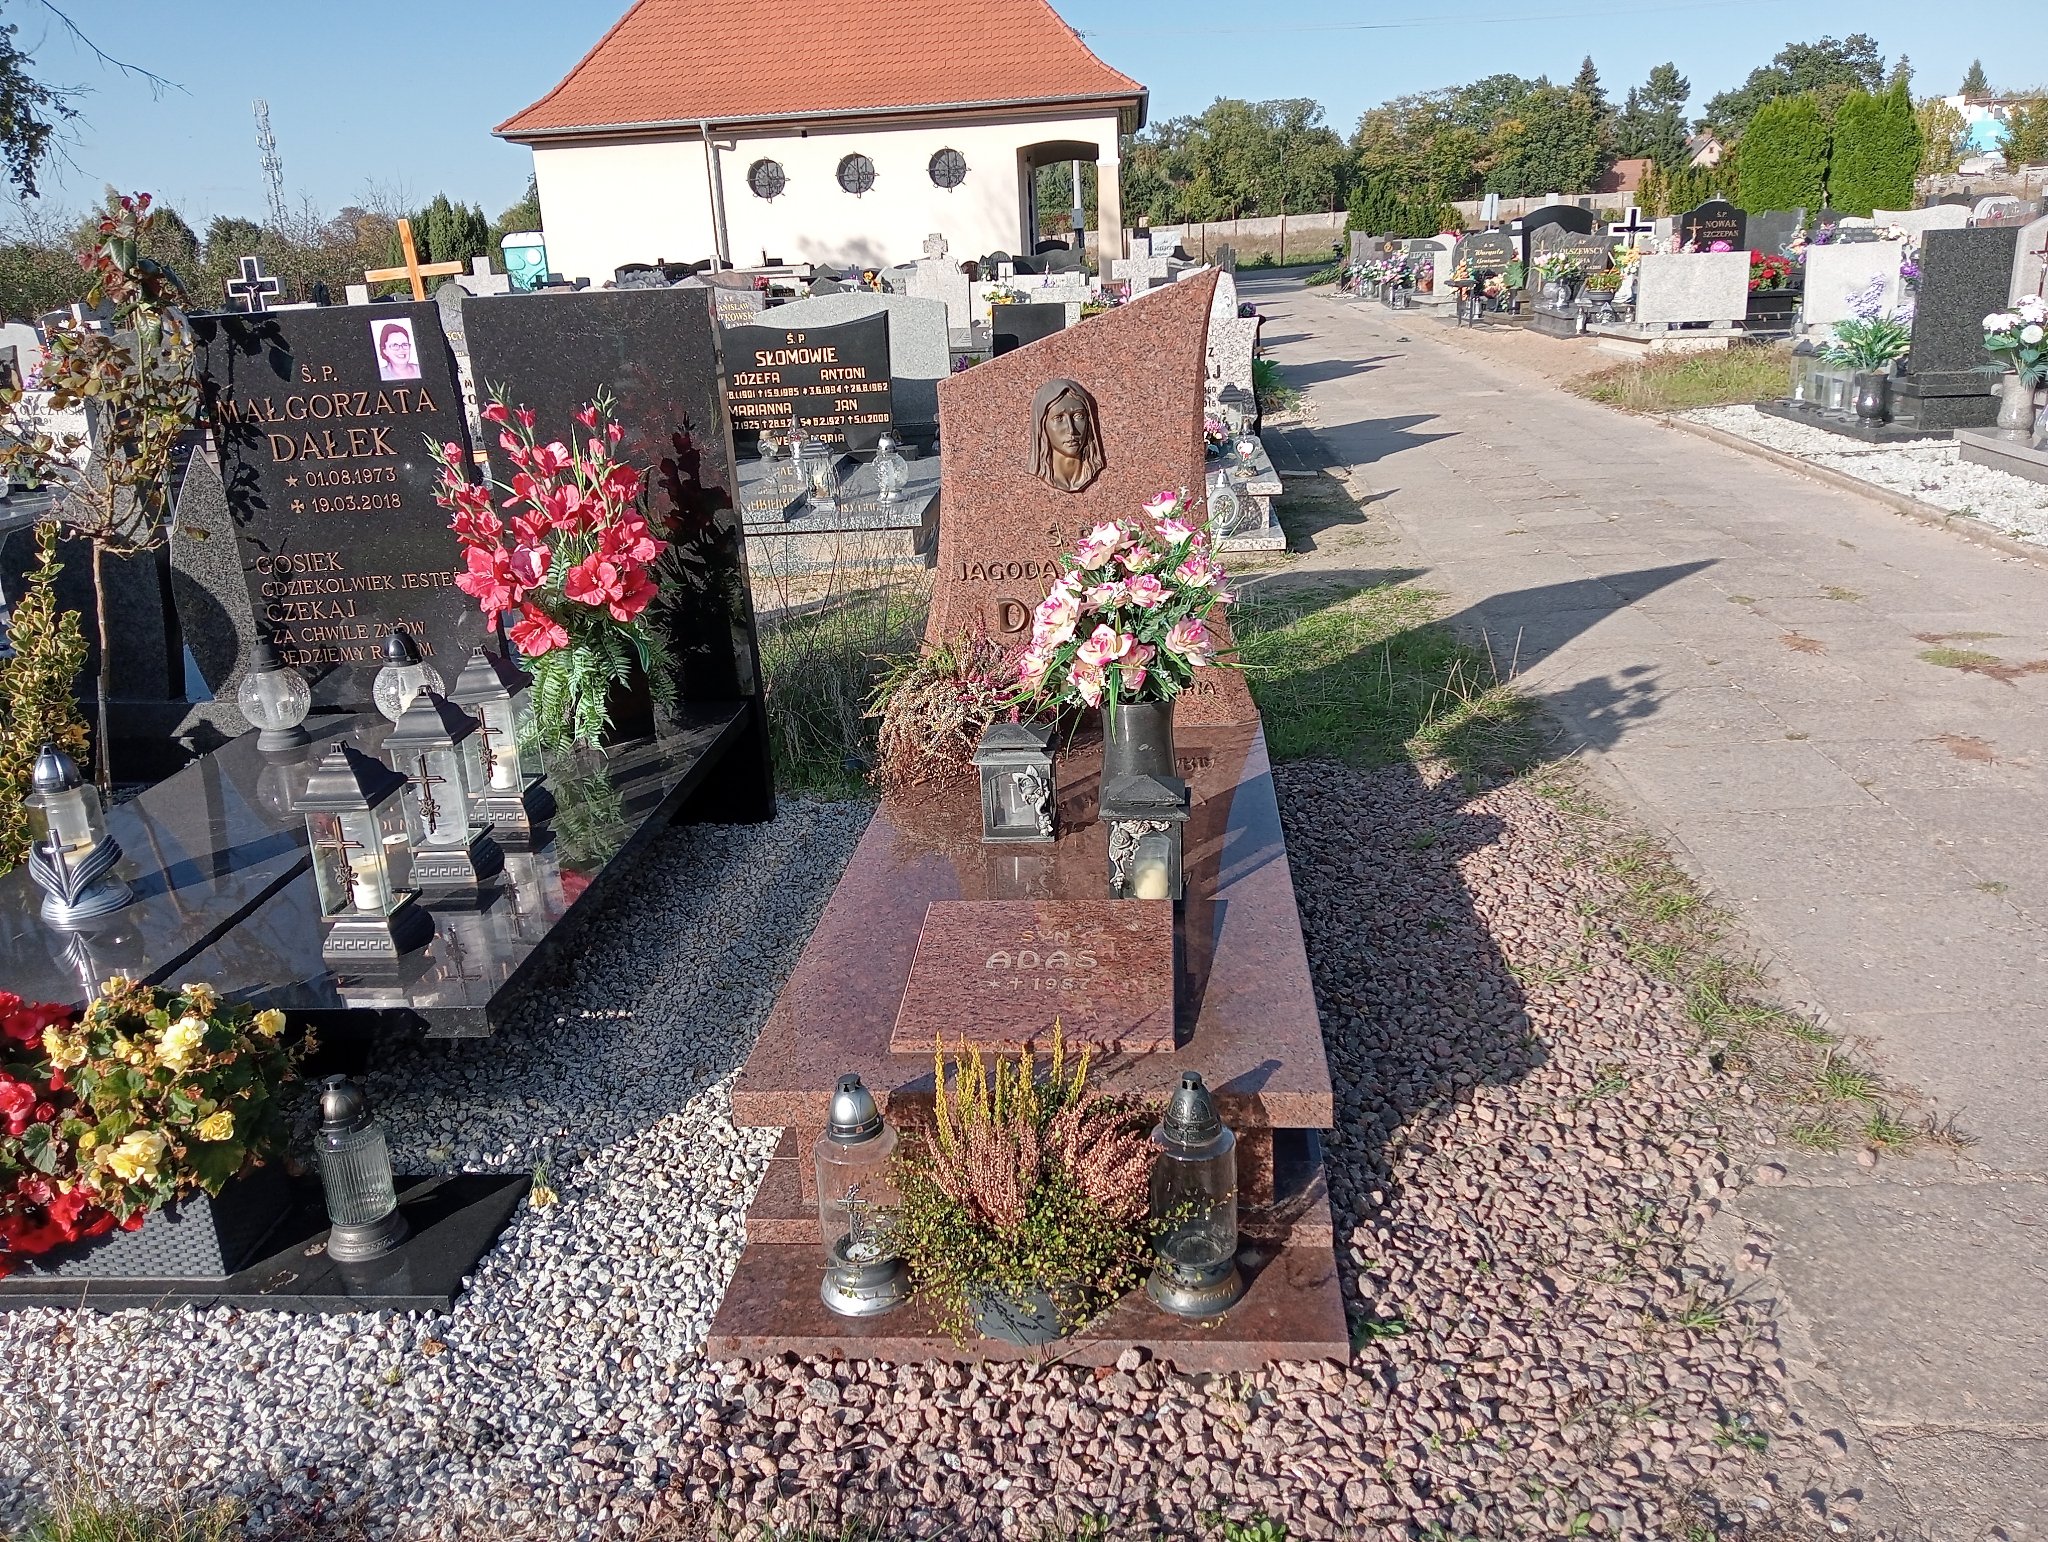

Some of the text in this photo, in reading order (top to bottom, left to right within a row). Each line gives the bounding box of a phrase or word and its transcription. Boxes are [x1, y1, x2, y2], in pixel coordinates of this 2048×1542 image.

[1705, 219, 1737, 228] NOWAK
[755, 346, 839, 367] SŁOMOWIE
[733, 370, 781, 386] JÓZEFA
[820, 366, 866, 381] ANTONI
[216, 386, 438, 426] MAŁGORZATA
[728, 402, 792, 417] MARIANNA
[834, 399, 858, 412] JAN
[268, 426, 398, 463] DAŁEK
[305, 466, 397, 488] 01.08.1973
[311, 493, 402, 514] 19.03.2018
[256, 551, 345, 575] GOSIEK
[958, 558, 1060, 582] JAGODA
[266, 599, 357, 622] CZEKAJ
[272, 629, 297, 644] ZA
